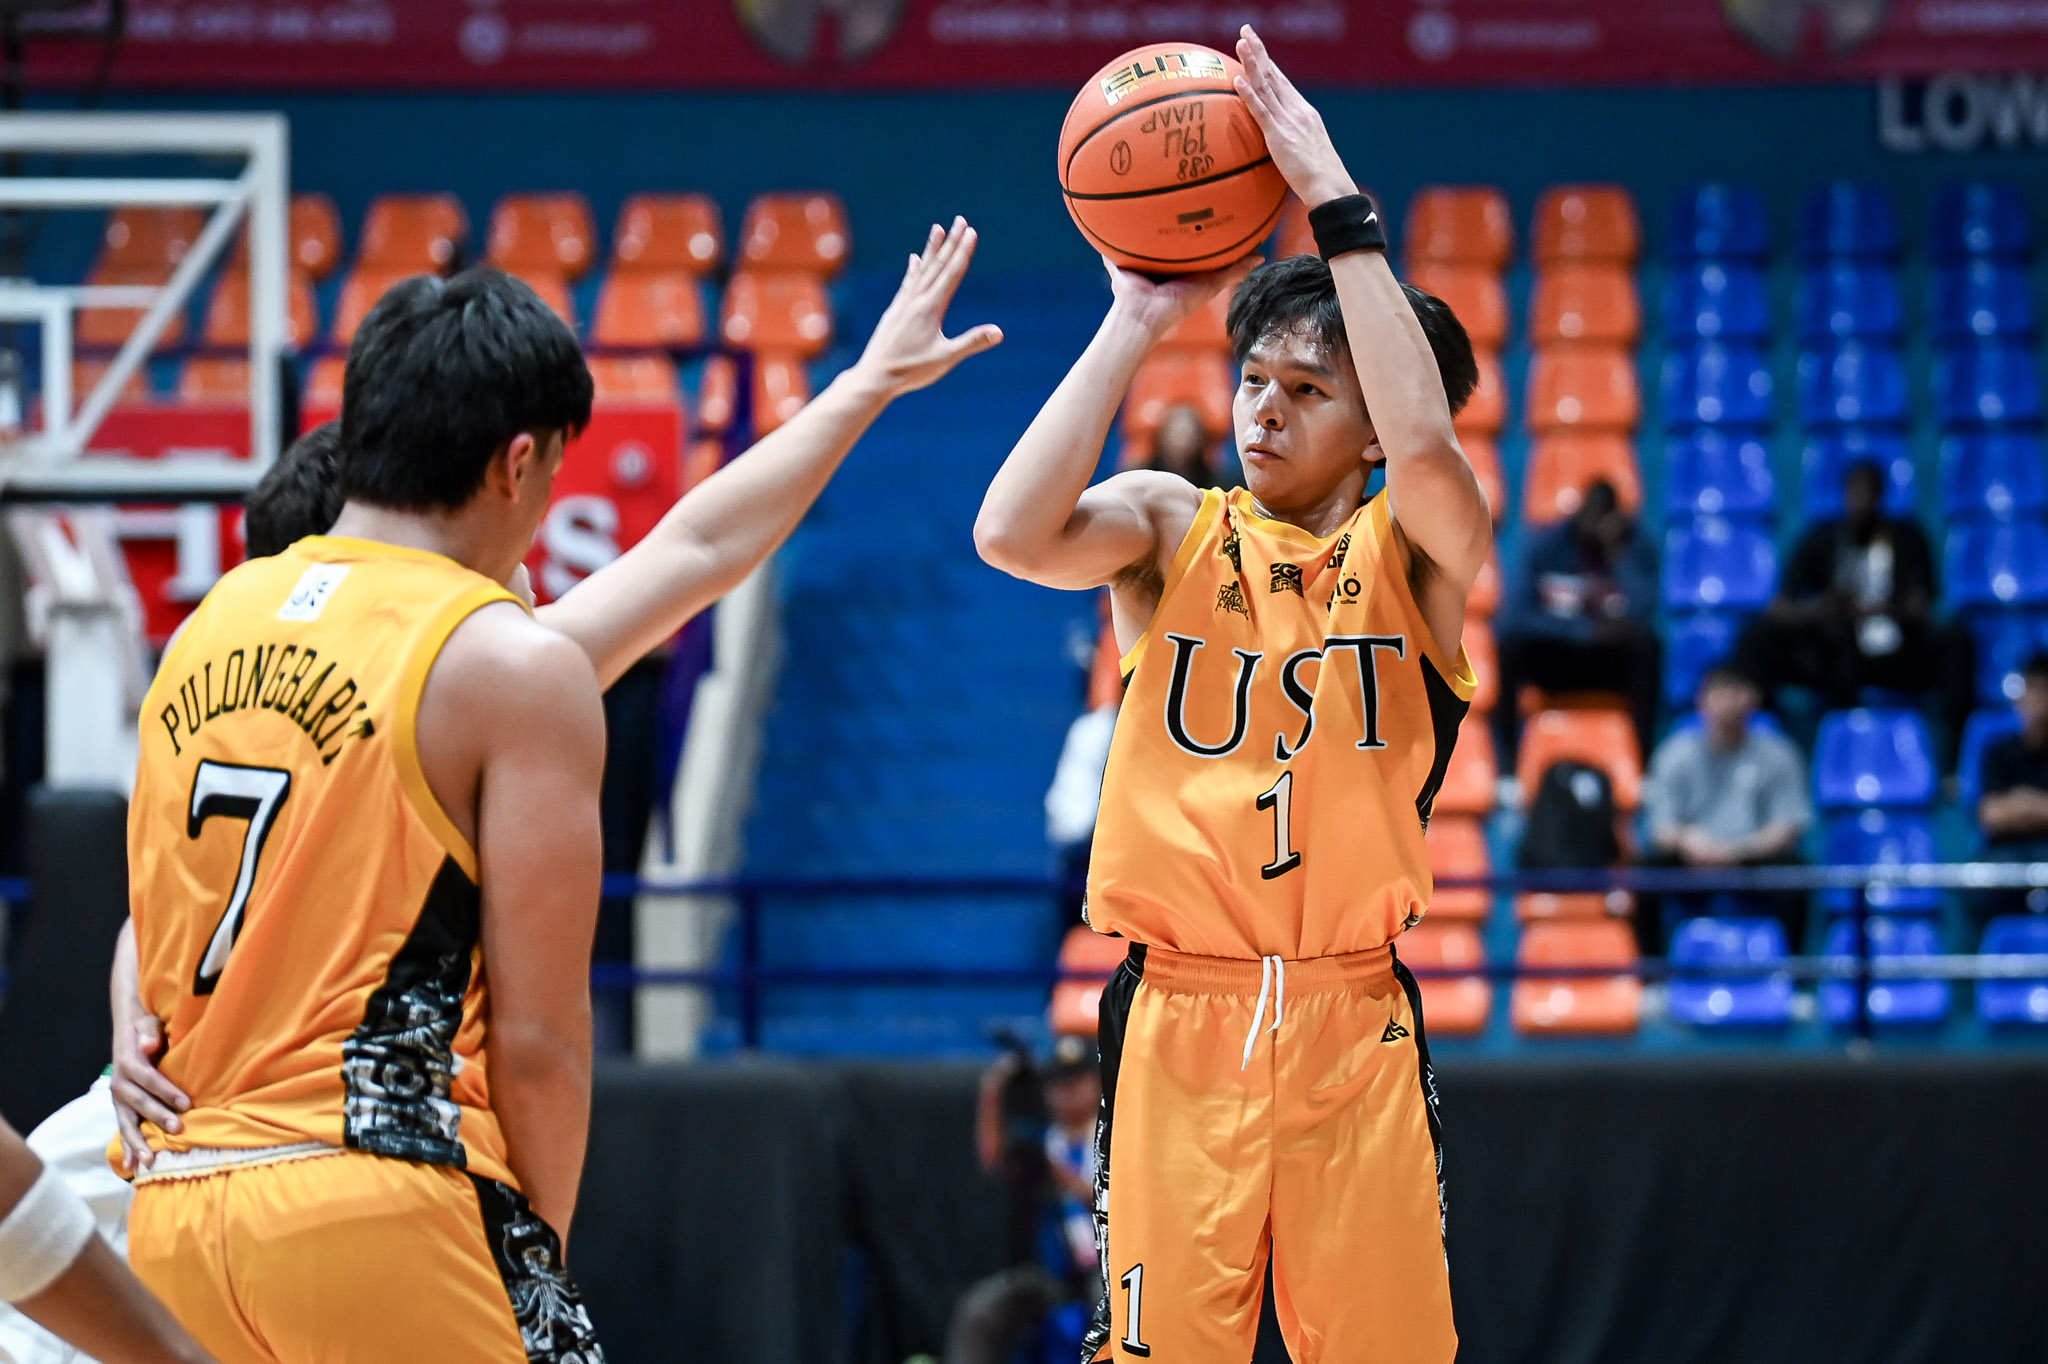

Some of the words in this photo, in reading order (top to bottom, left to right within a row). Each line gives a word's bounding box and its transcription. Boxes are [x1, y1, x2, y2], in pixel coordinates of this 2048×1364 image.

[1100, 51, 1225, 95] ELITE
[1141, 101, 1204, 134] UAAP
[1164, 631, 1406, 763] UST
[187, 757, 292, 996] 7
[1256, 770, 1301, 880] 1
[1121, 1262, 1150, 1358] 1
